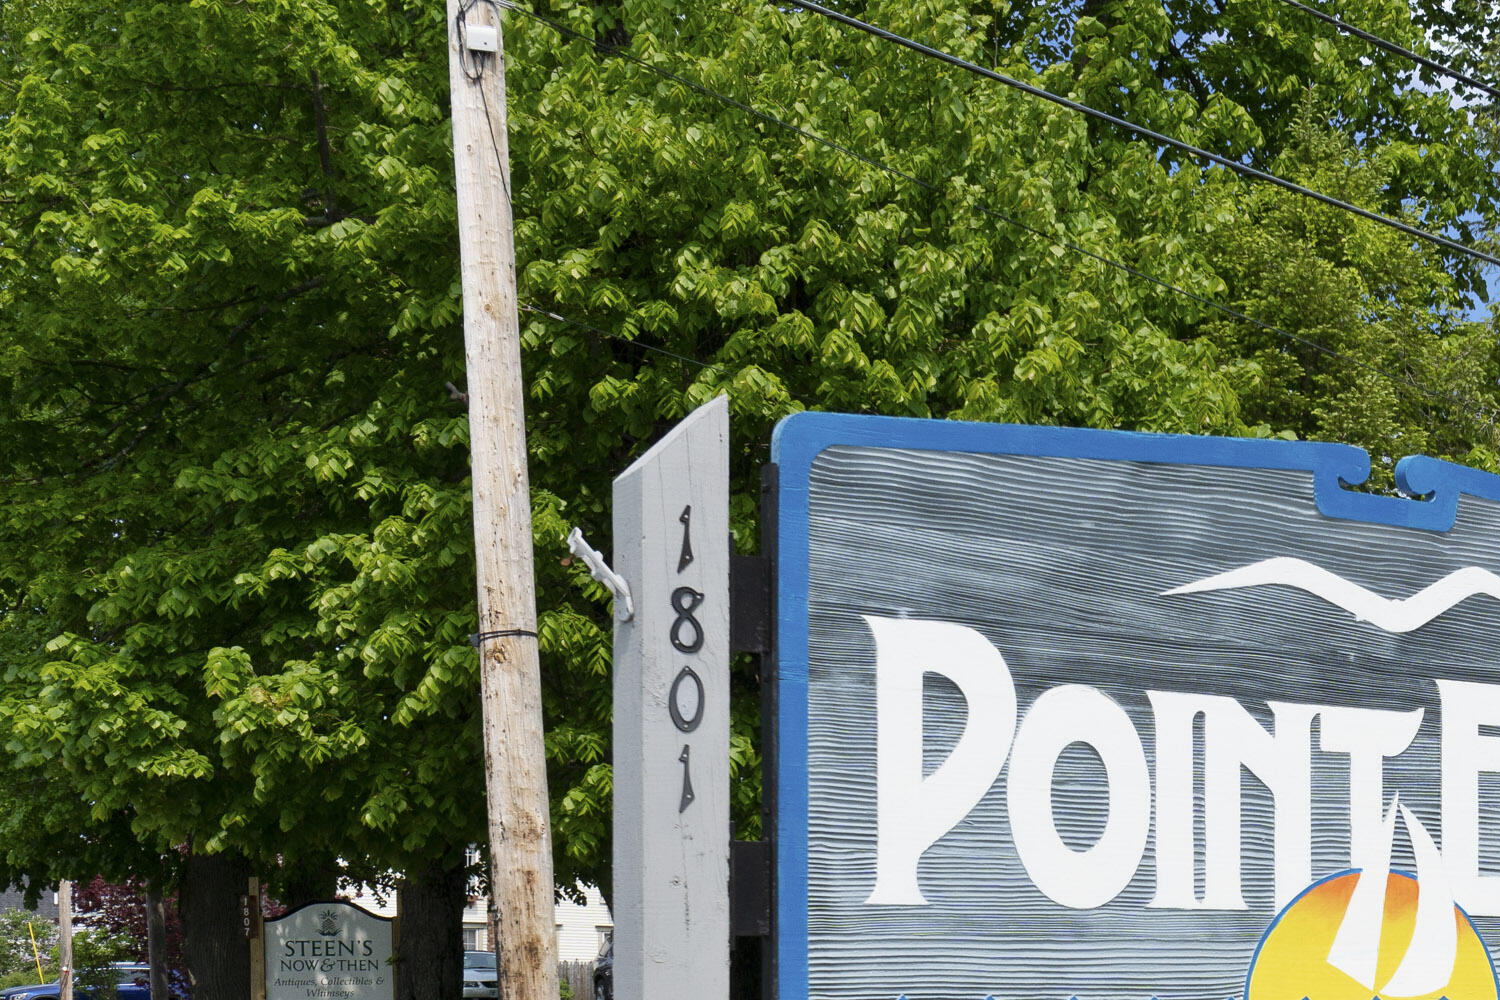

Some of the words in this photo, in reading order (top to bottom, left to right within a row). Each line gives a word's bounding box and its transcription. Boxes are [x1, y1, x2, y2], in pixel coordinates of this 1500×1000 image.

[669, 504, 705, 814] 1801
[285, 939, 373, 958] STEEN'S
[280, 959, 319, 972] NOW
[320, 958, 335, 973] &
[337, 959, 379, 972] THEN
[274, 977, 318, 988] Antiques,
[320, 976, 373, 986] Collectibles
[375, 976, 384, 985] &
[306, 988, 354, 999] Whimseys
